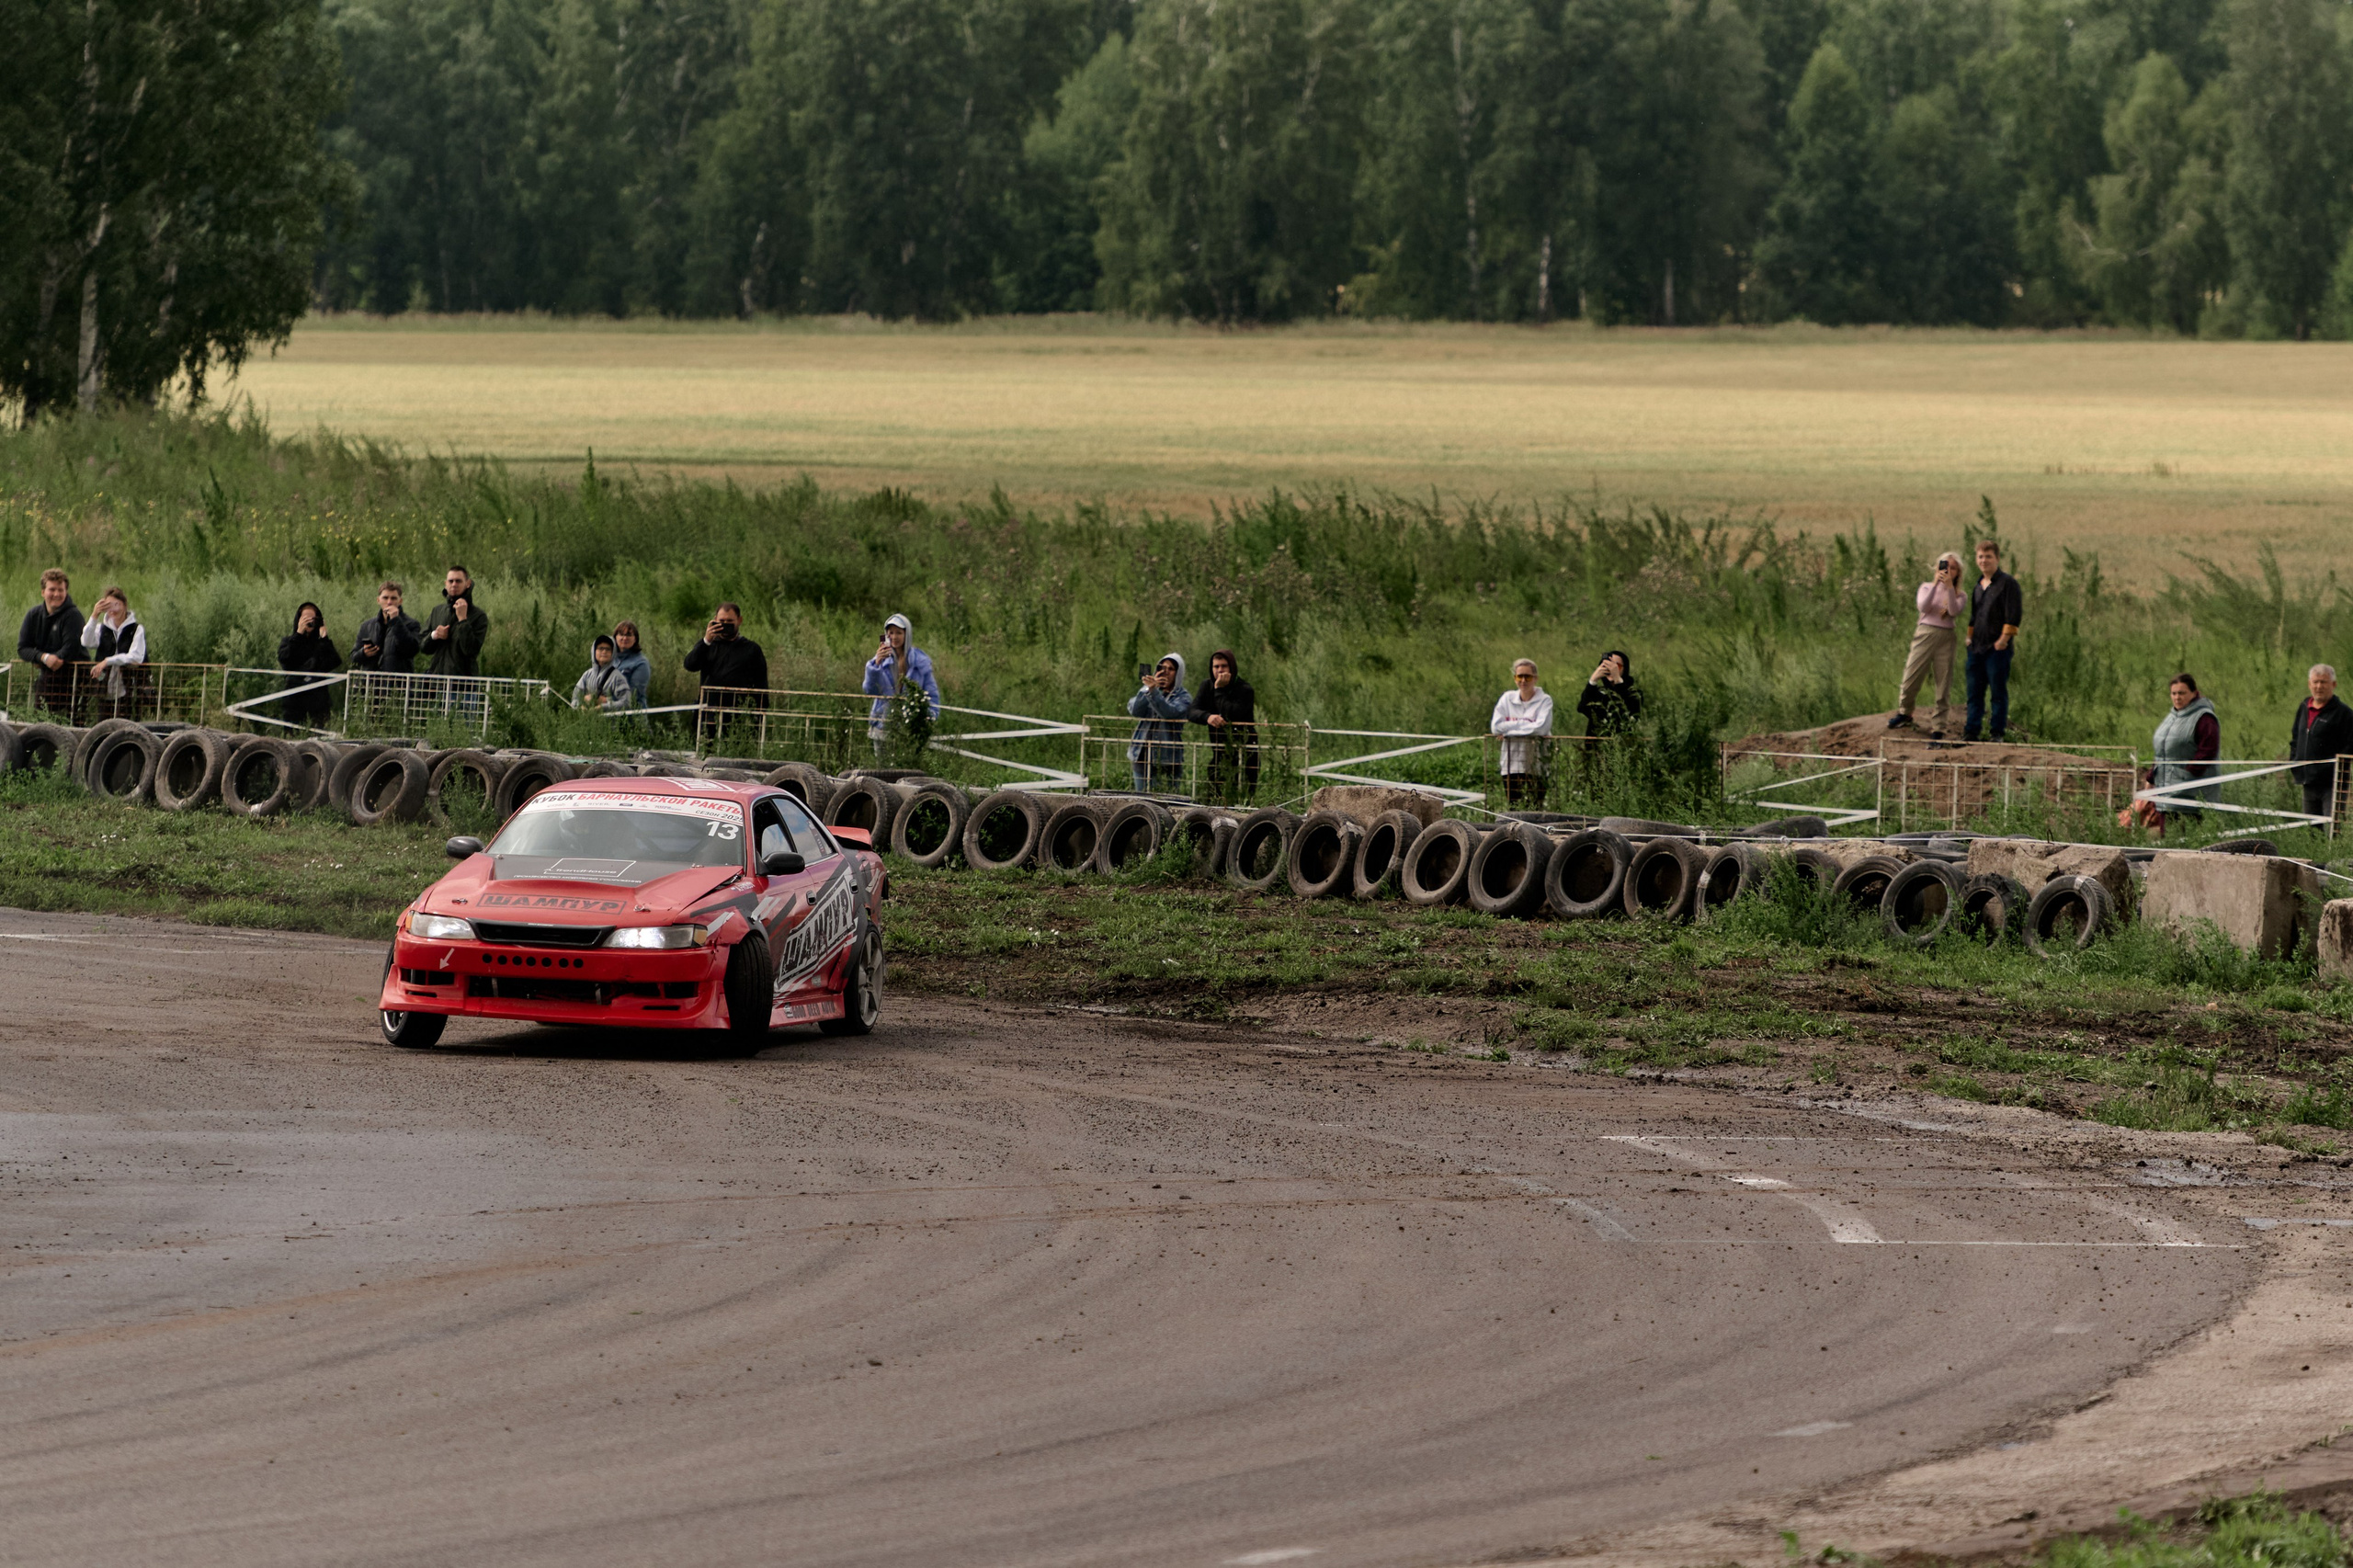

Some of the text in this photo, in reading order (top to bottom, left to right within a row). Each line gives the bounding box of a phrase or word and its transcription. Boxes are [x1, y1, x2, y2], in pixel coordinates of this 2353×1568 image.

[532, 794, 576, 804] КУБОК
[577, 793, 688, 805] БАРНАУЛЬСКОЙ
[707, 821, 739, 840] 13
[483, 895, 619, 911] ШАМПУР
[781, 889, 849, 977] ШАМПУР
